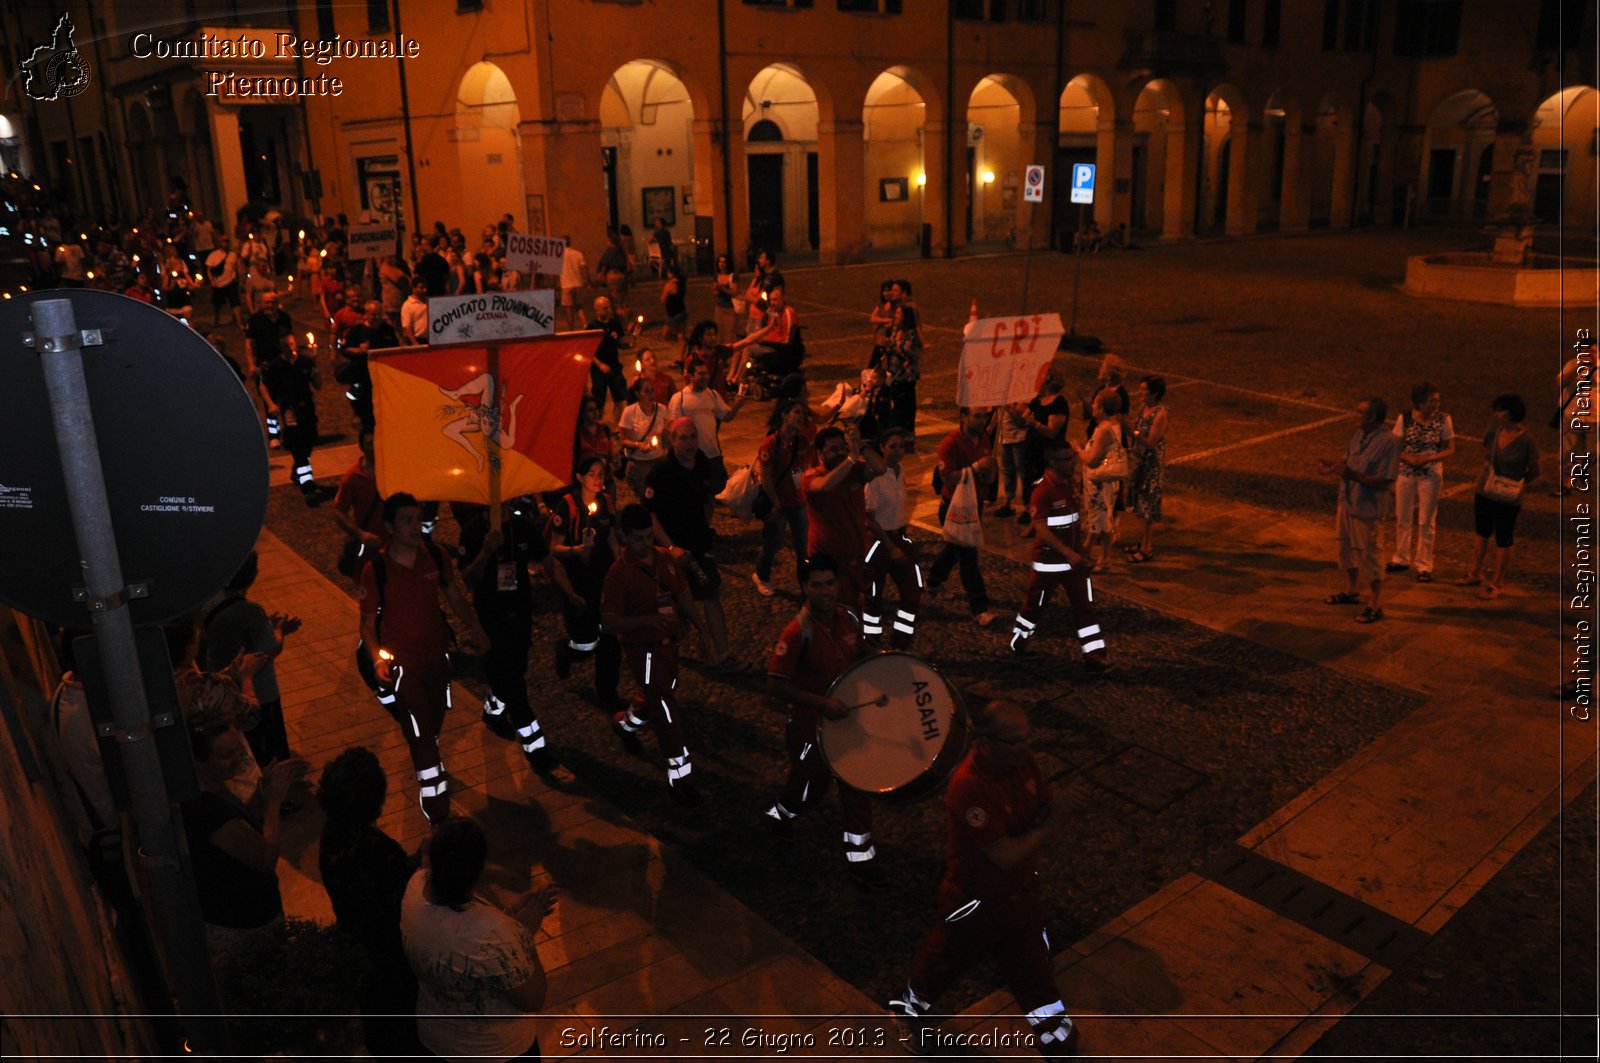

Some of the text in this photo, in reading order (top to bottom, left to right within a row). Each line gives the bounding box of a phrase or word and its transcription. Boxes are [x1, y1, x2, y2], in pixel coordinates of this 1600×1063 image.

[1076, 165, 1092, 188] P
[510, 235, 563, 258] COSSATO
[432, 298, 487, 334] COMITATO
[491, 295, 553, 329] PROVINCIALE
[991, 314, 1042, 359] CRI
[140, 504, 180, 512] CASTIGLIONE
[159, 496, 195, 504] COMUNE DI
[912, 681, 940, 741] ASAHI
